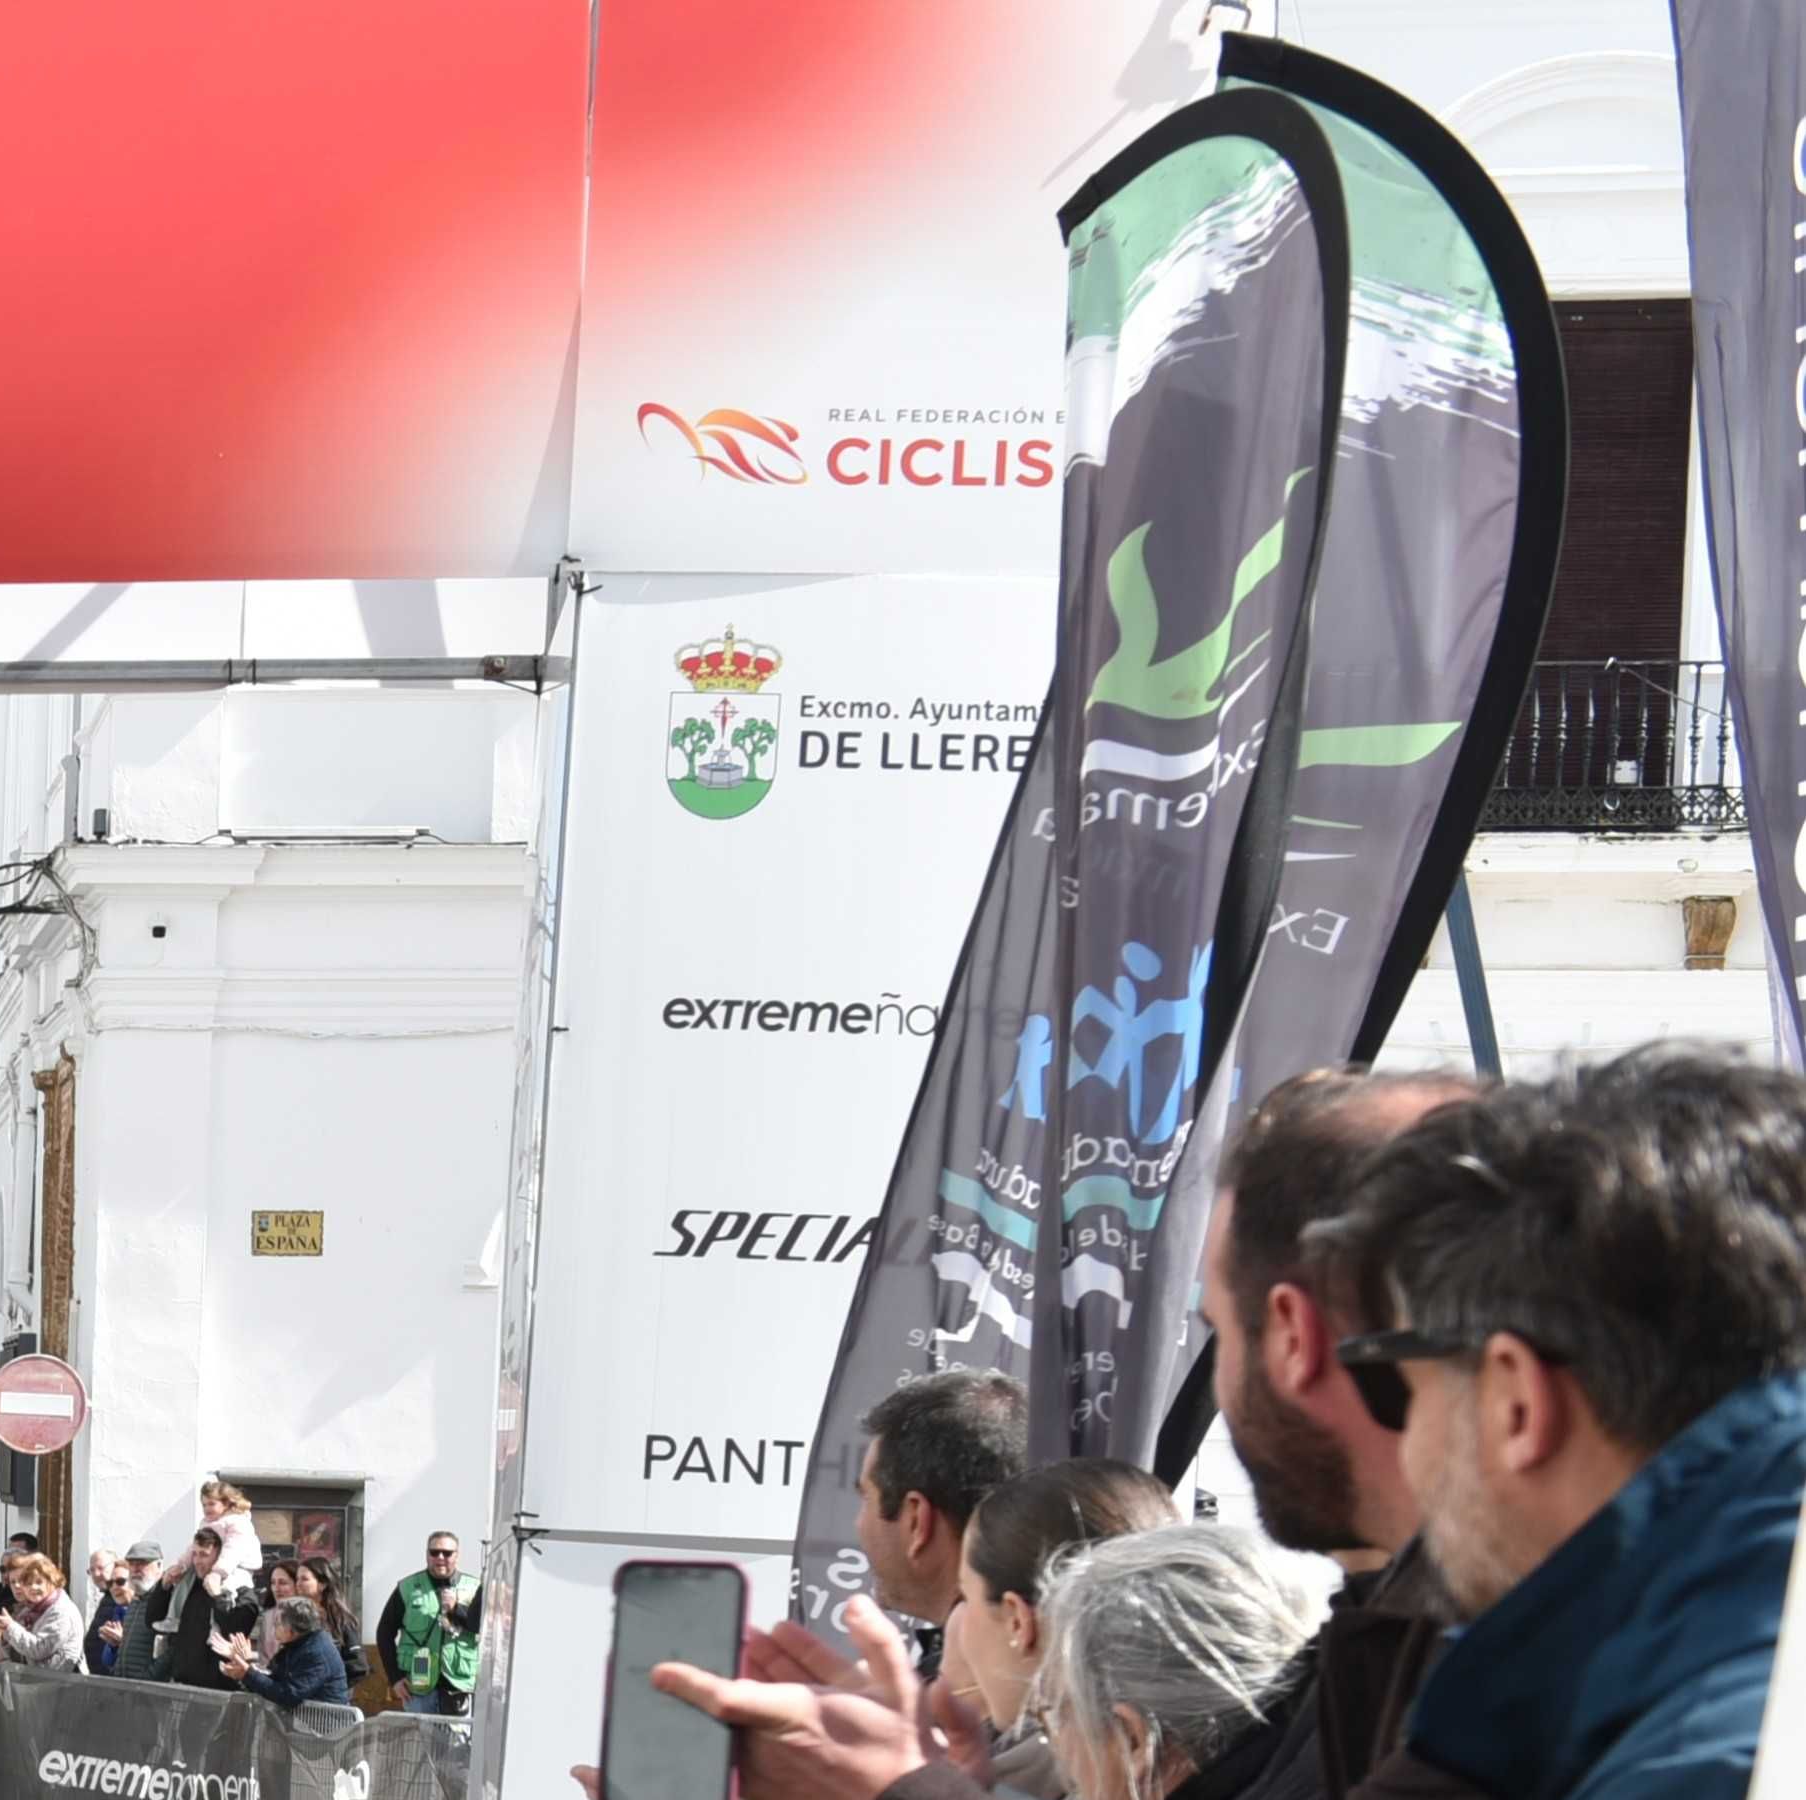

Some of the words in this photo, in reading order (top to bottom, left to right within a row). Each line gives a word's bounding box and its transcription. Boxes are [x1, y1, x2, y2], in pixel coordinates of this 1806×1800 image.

[828, 407, 886, 424] REAL
[896, 405, 1042, 425] FEDERACIÓN
[825, 438, 1055, 487] CICLIS
[799, 695, 899, 720] Excmo.
[908, 698, 1046, 727] Ayuntam
[798, 731, 862, 769] DE
[879, 733, 1032, 774] LLERE
[661, 992, 938, 1036] extremeña
[274, 1214, 311, 1227] PLAZA
[653, 1209, 884, 1264] SPECIA
